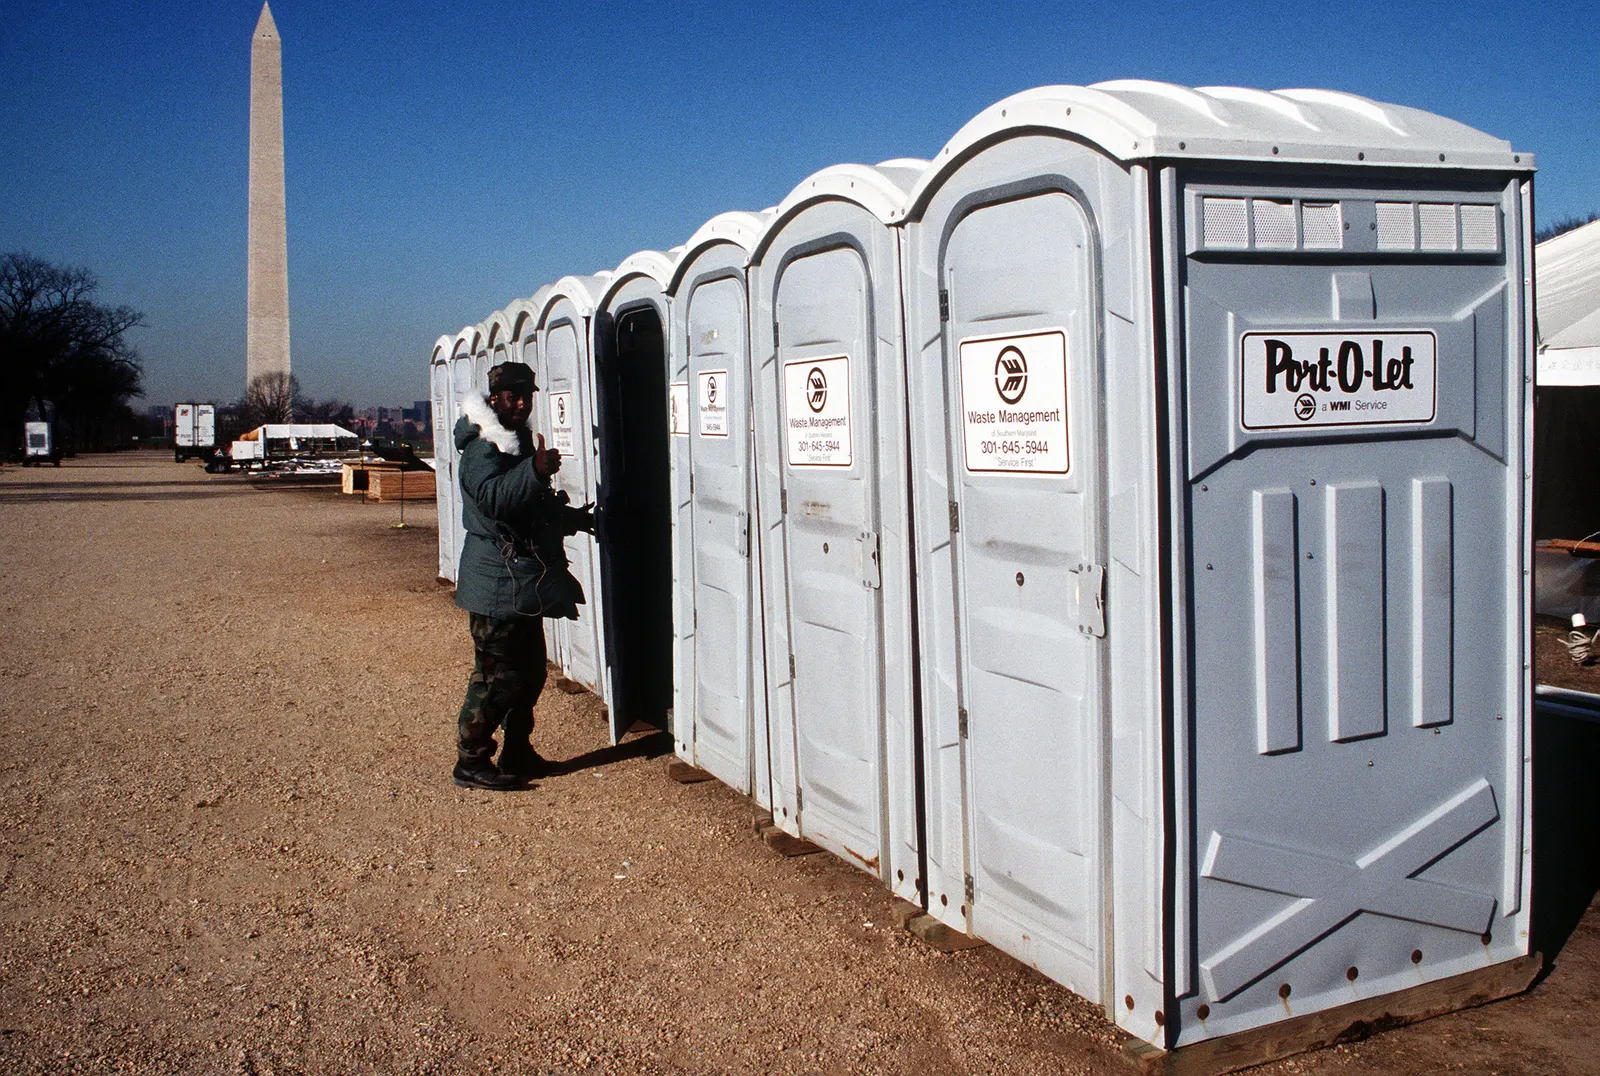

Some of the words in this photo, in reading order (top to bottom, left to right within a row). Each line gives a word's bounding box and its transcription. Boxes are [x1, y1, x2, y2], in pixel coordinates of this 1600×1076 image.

[1263, 339, 1414, 394] Port-O-Let
[1321, 402, 1328, 412] a
[1329, 400, 1351, 411] WMI
[1354, 399, 1388, 411] Service
[789, 418, 808, 429] Waste
[809, 416, 846, 429] Management
[968, 411, 996, 424] Waste
[999, 408, 1060, 425] Management
[798, 440, 840, 452] 301-645-5944
[981, 440, 1049, 454] 301-645-5944
